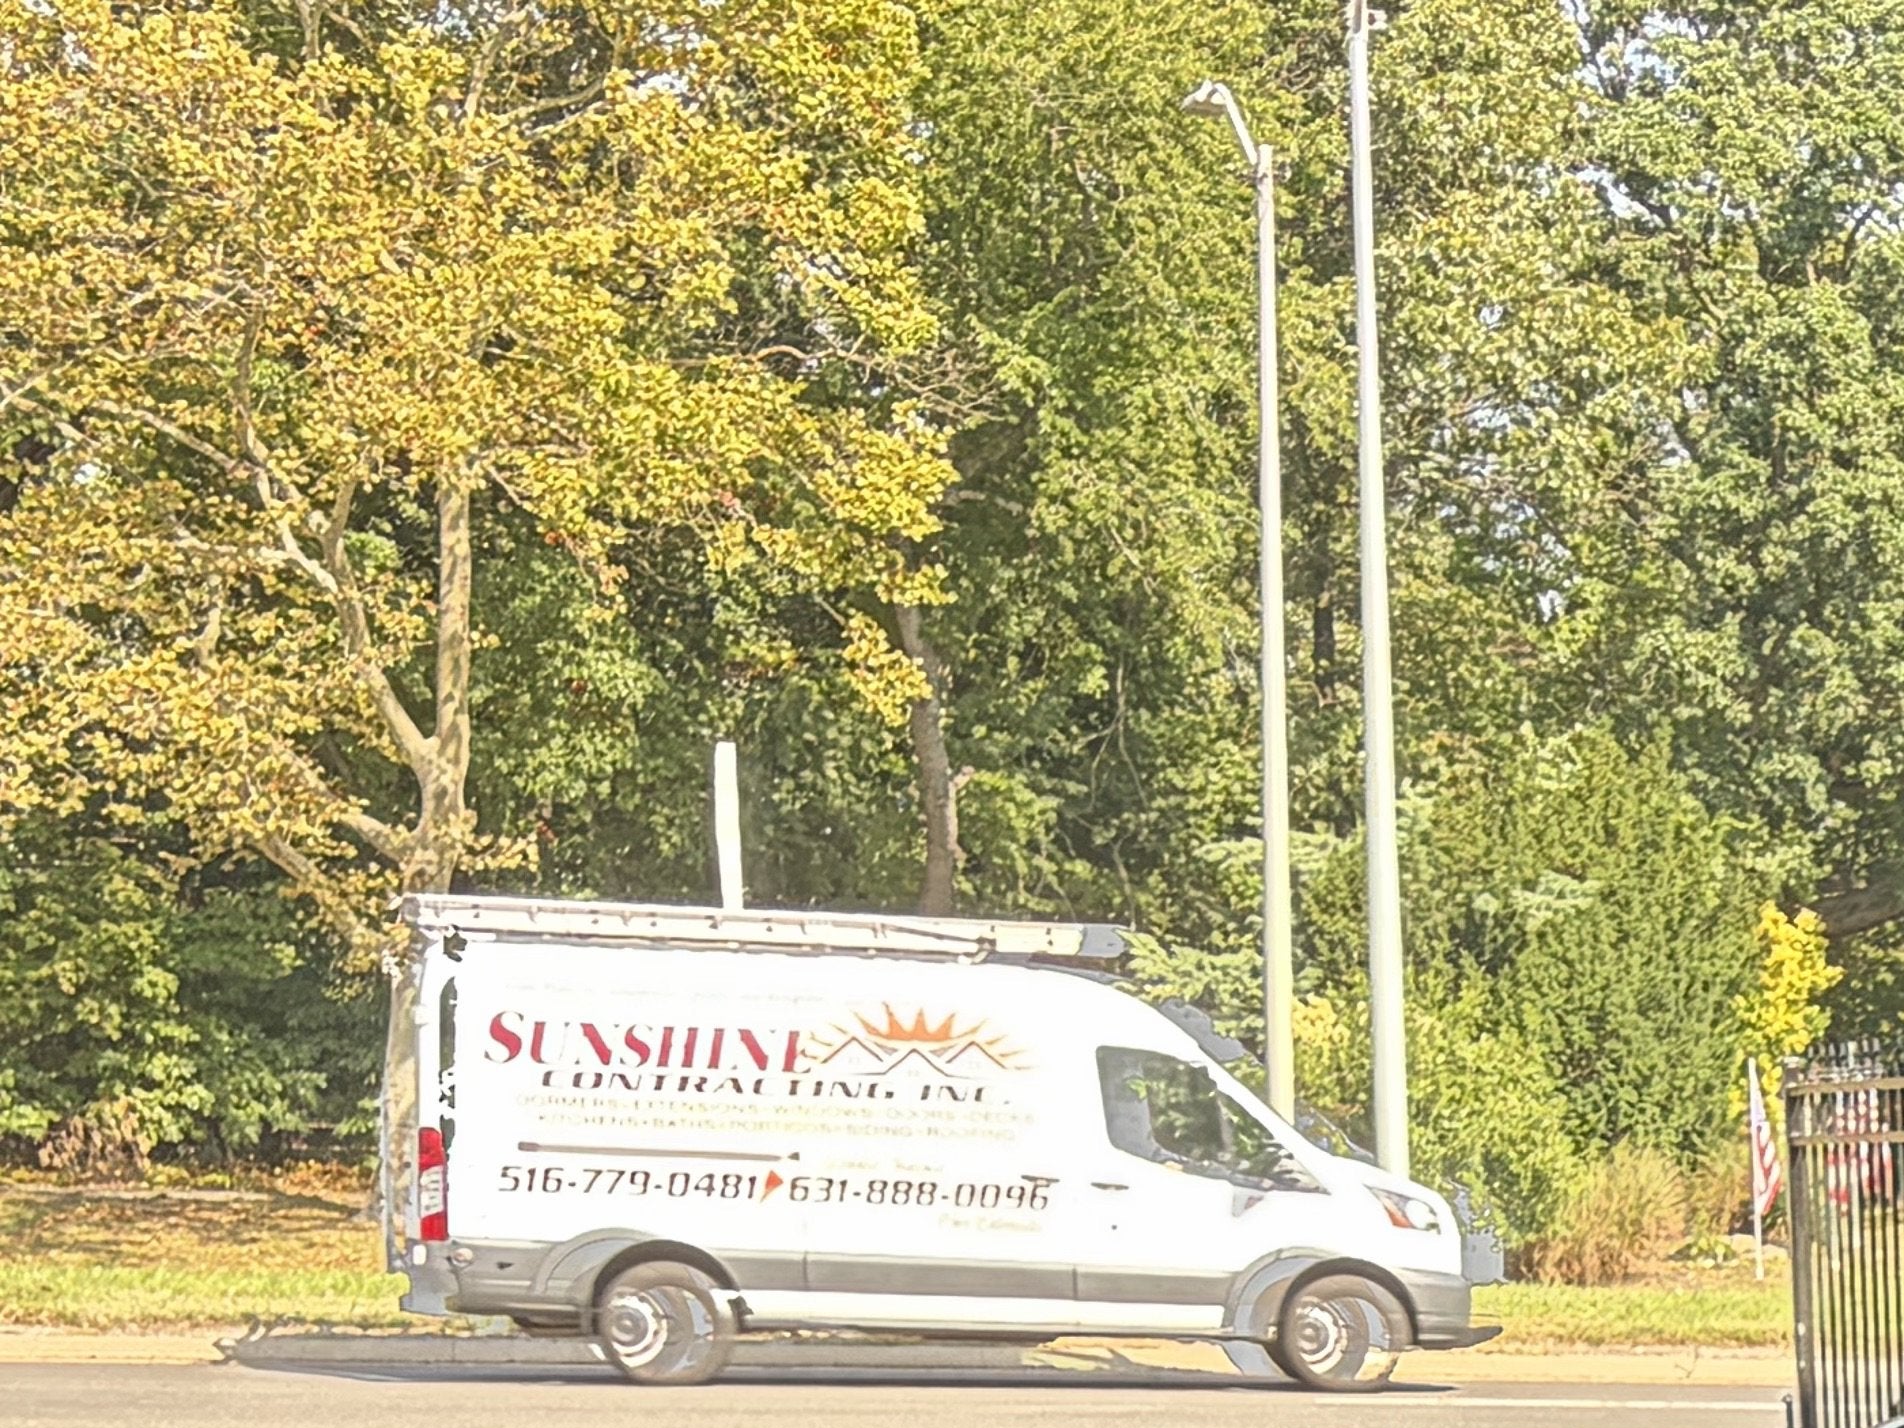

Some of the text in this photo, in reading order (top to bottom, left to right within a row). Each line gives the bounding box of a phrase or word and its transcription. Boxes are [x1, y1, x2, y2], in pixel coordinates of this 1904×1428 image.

[484, 1010, 812, 1074] SUNSHINE
[541, 1069, 1011, 1104] CONTRACTING INC.
[498, 1165, 1051, 1210] 516-779-0481 631-888-0096
